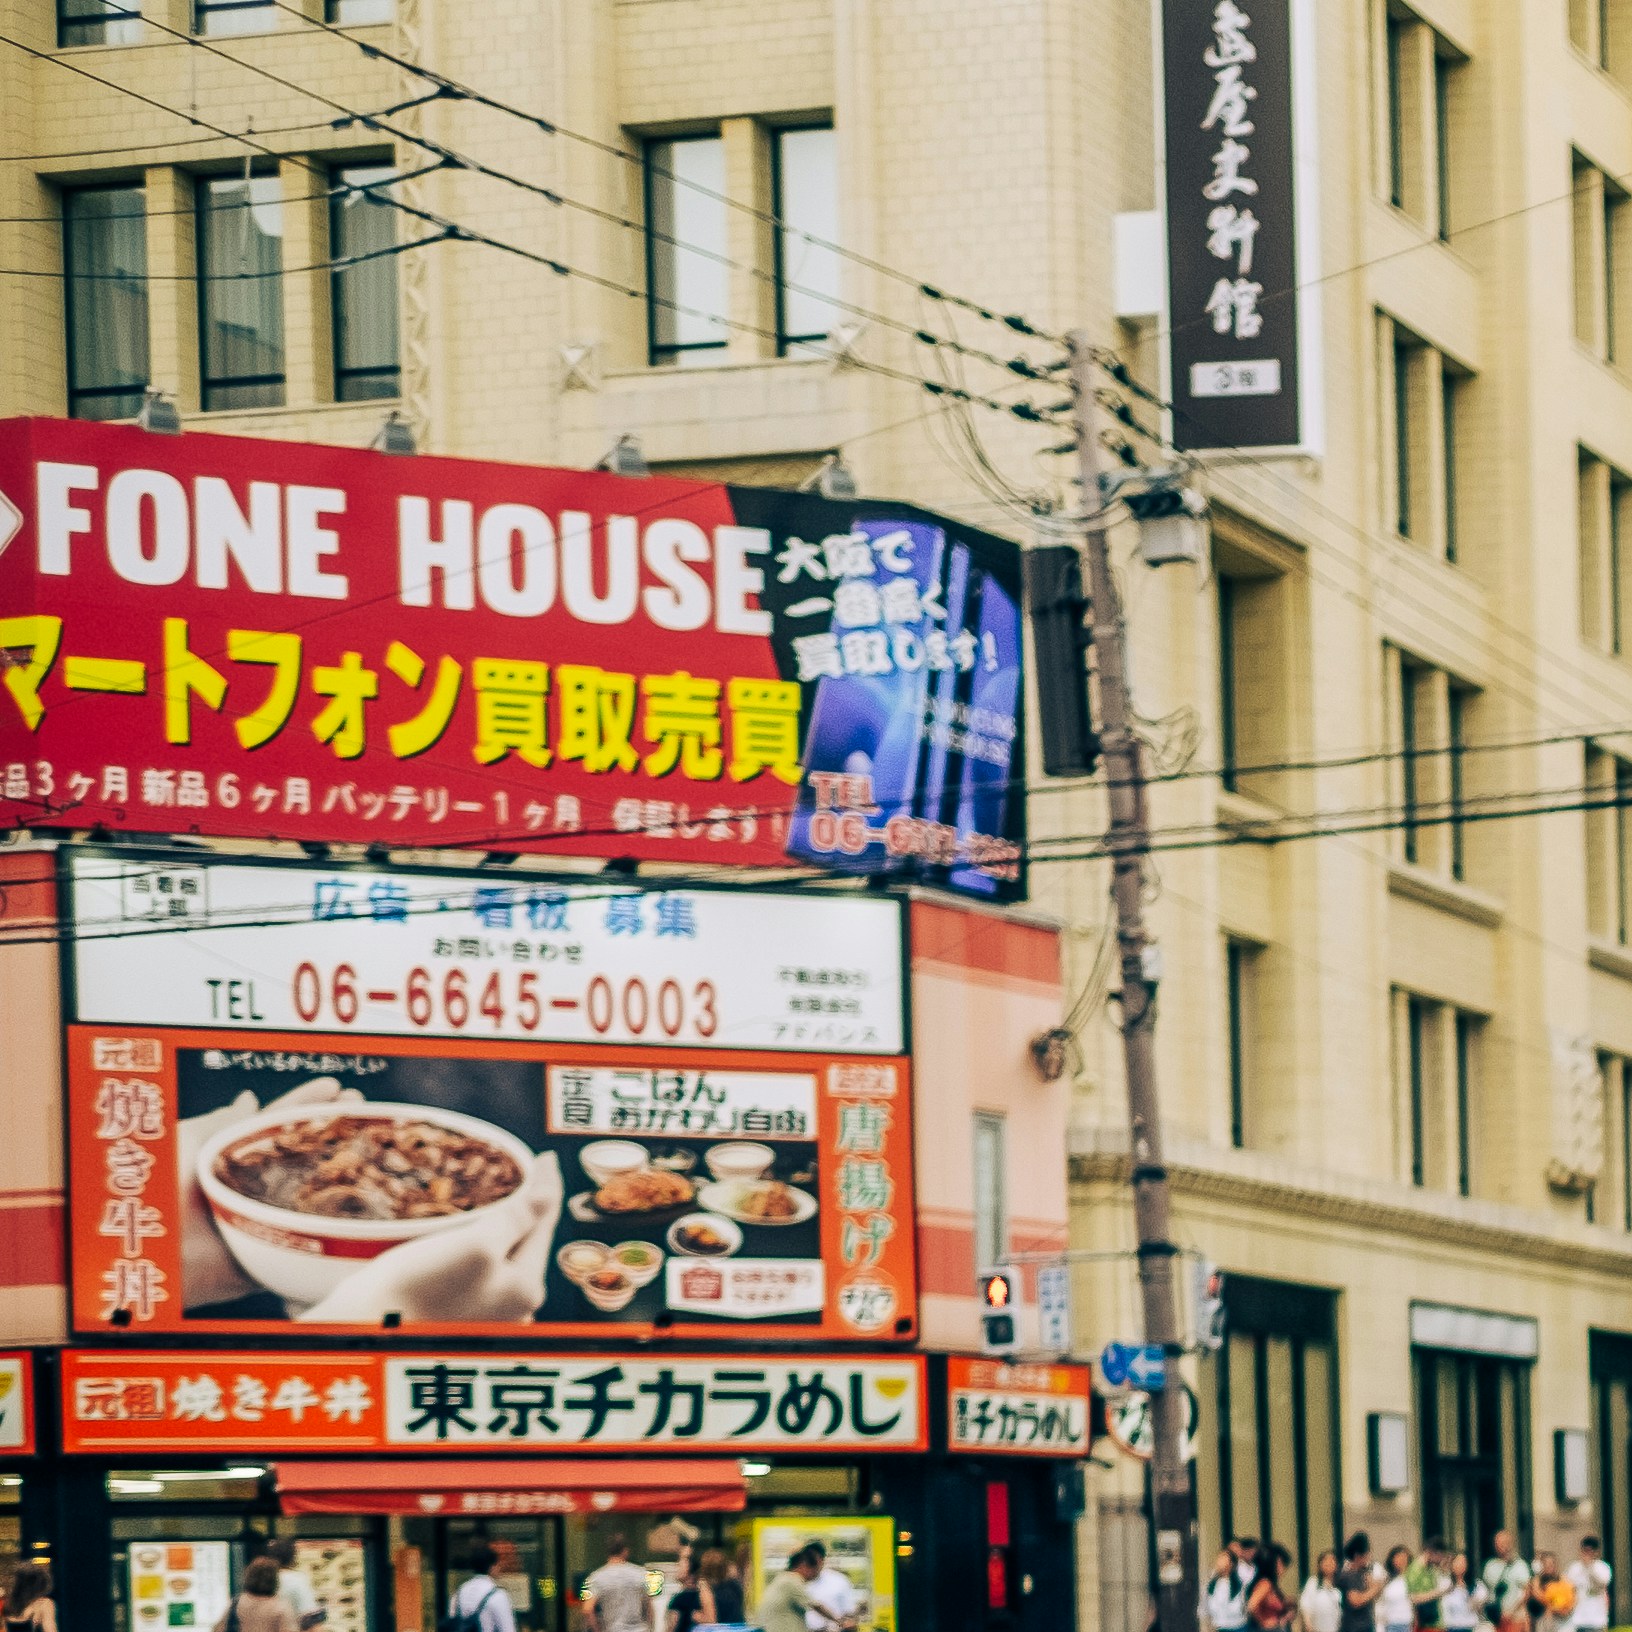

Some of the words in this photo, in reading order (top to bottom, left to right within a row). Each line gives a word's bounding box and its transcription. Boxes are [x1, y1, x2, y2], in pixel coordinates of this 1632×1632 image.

[36, 461, 349, 601] FONE
[398, 494, 775, 637] HOUSE
[775, 529, 916, 584] 大阪で
[0, 614, 804, 787] マートフォン買取売買
[433, 938, 583, 963] お問い合わせ
[604, 893, 698, 938] 募集
[205, 979, 264, 1021] TEL
[293, 961, 719, 1038] 06-6645-0003
[611, 1071, 728, 1104] ごはん
[834, 1102, 896, 1268] 唐揚げ
[171, 1374, 373, 1426] 焼き牛丼
[404, 1364, 902, 1443] 東京チカラめし
